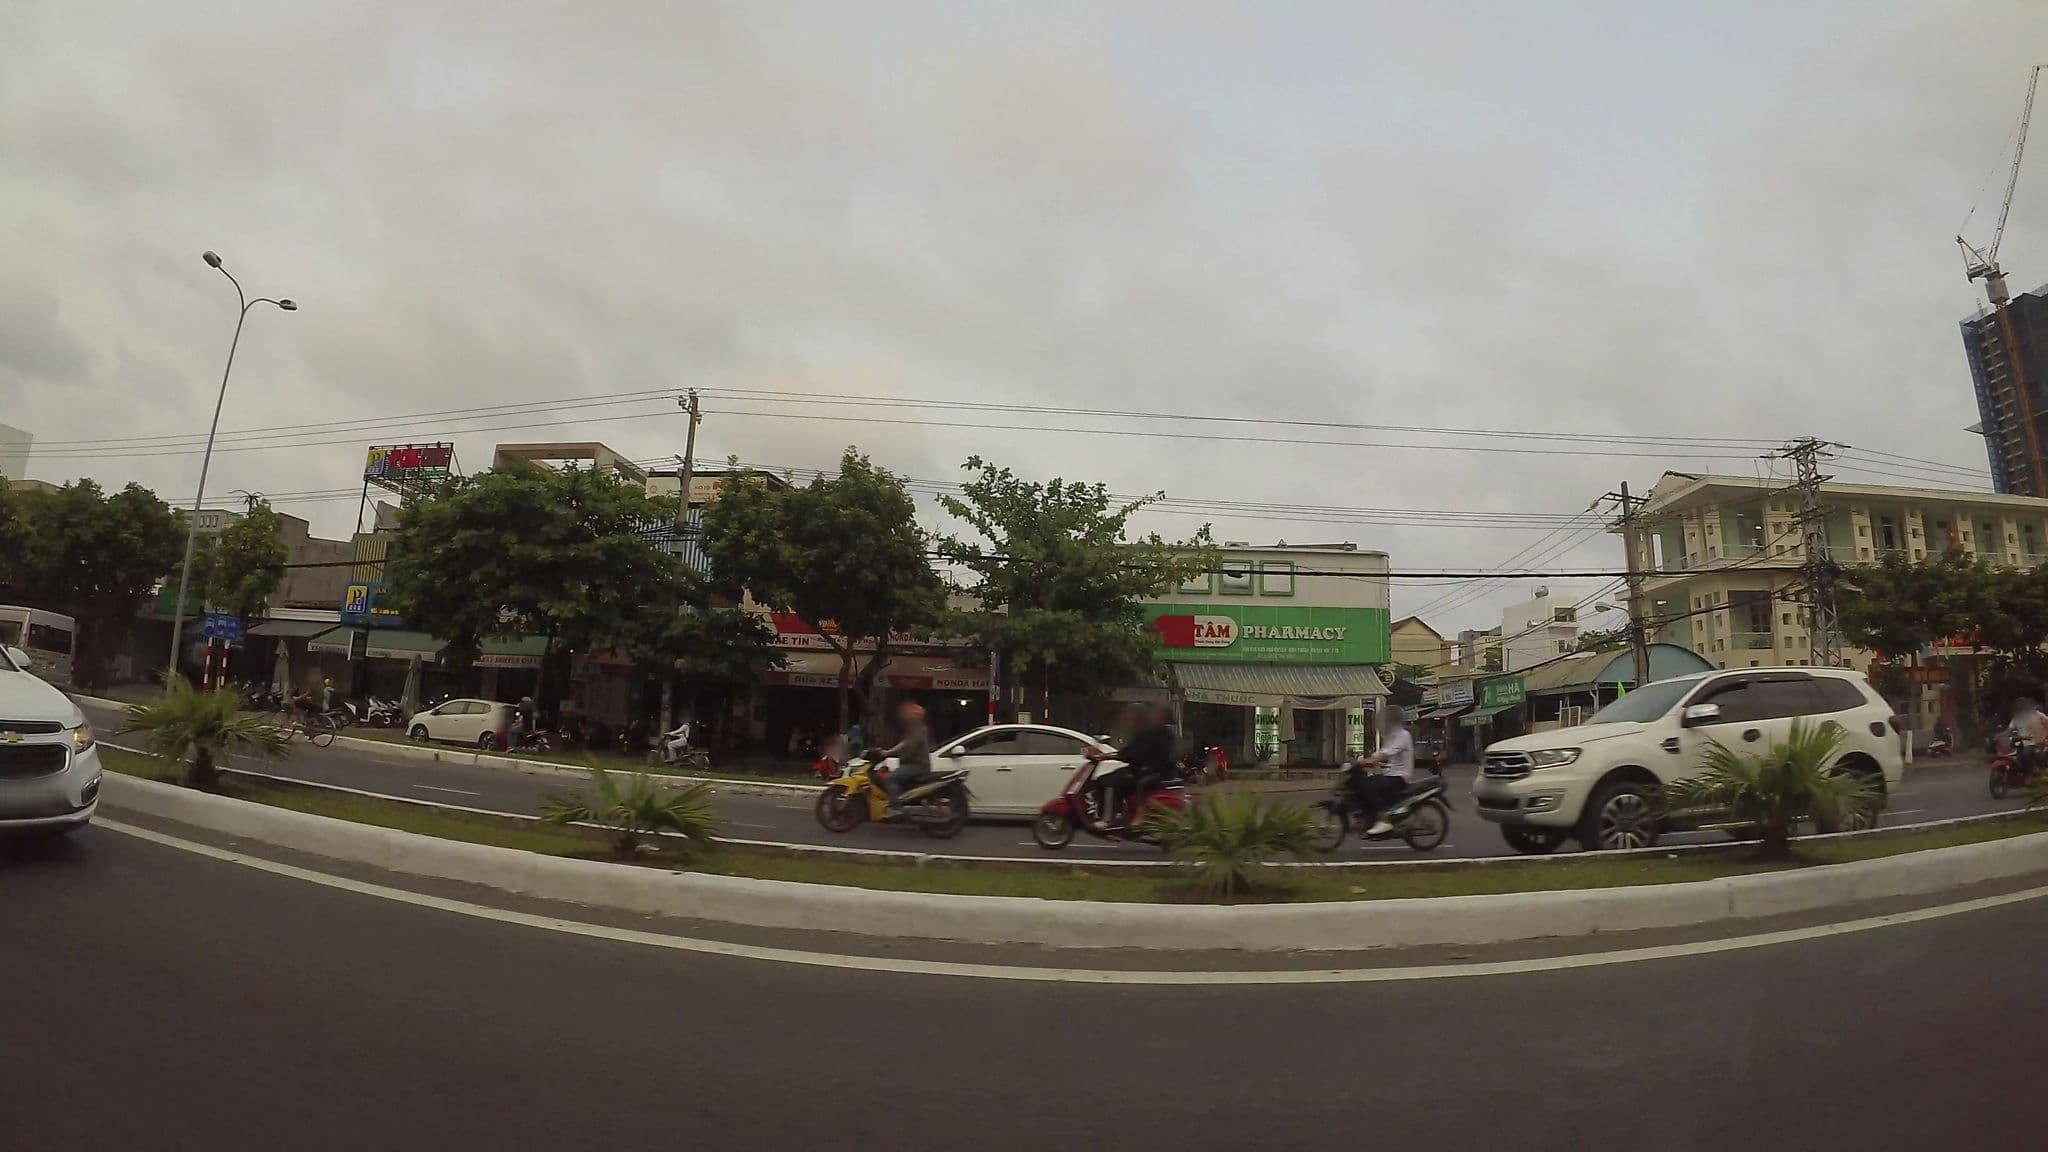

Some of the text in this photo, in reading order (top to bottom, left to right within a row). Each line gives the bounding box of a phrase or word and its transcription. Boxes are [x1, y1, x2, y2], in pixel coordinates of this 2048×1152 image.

[1194, 621, 1230, 638] TÂM
[1242, 625, 1347, 641] PHARMACY
[936, 679, 969, 688] HONDA
